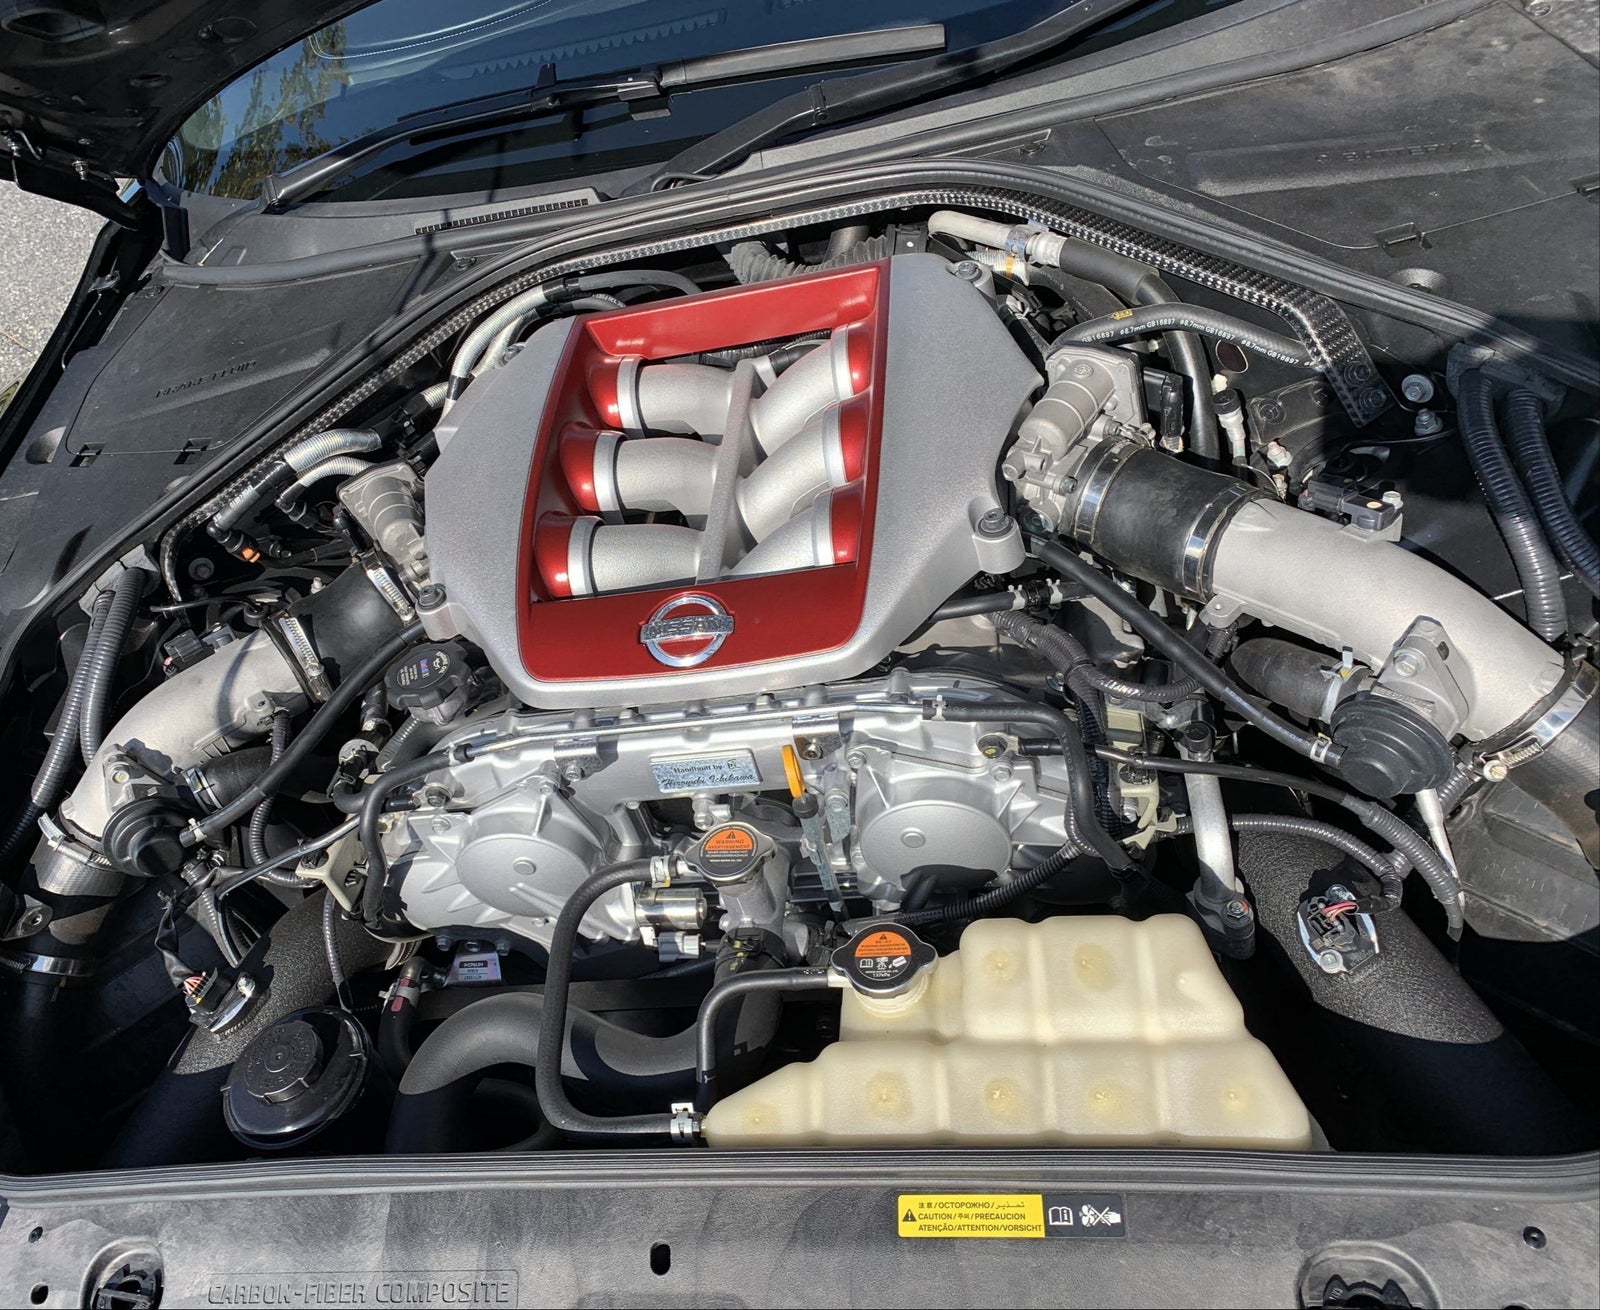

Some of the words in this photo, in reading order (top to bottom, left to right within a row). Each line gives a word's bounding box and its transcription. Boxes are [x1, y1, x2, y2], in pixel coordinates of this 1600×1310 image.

[643, 614, 734, 640] NISSAN
[207, 1282, 367, 1304] CARBON-FIBER
[375, 1281, 510, 1304] COMPOSITE
